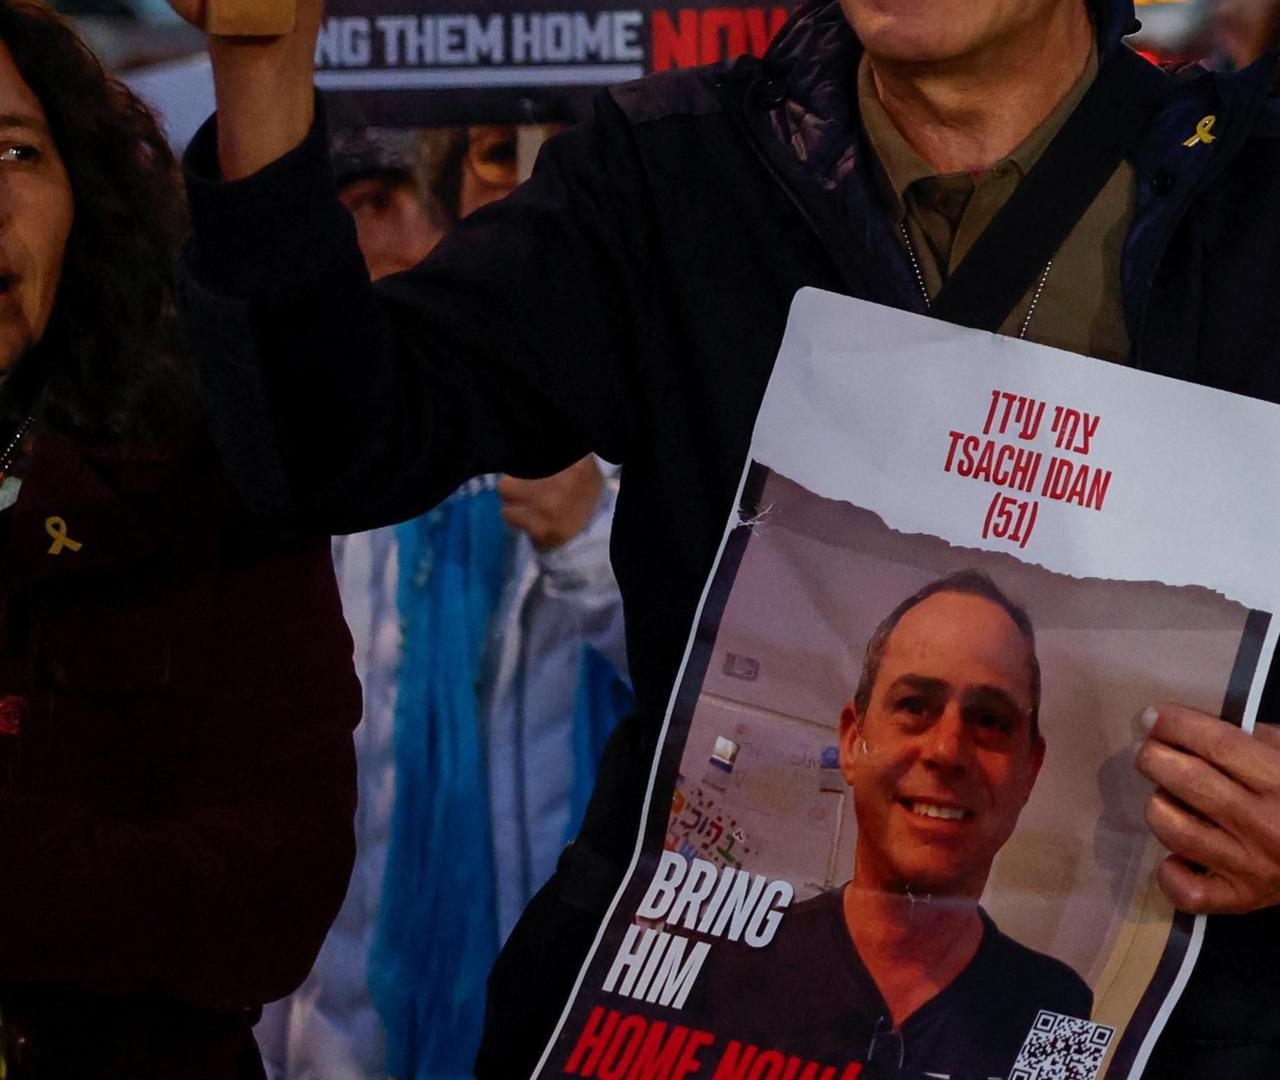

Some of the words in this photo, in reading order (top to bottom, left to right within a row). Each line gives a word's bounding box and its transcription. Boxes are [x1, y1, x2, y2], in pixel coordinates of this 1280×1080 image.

[377, 14, 501, 65] THEM
[511, 10, 644, 64] HOME
[982, 390, 1046, 441] עידן
[1051, 405, 1101, 455] צחי
[944, 430, 1043, 493] TSACHI
[1041, 456, 1112, 511] IDAN
[982, 492, 1039, 548] (51)
[635, 849, 794, 948] BRING
[602, 924, 712, 1010] HIM
[564, 1005, 715, 1080] HOME
